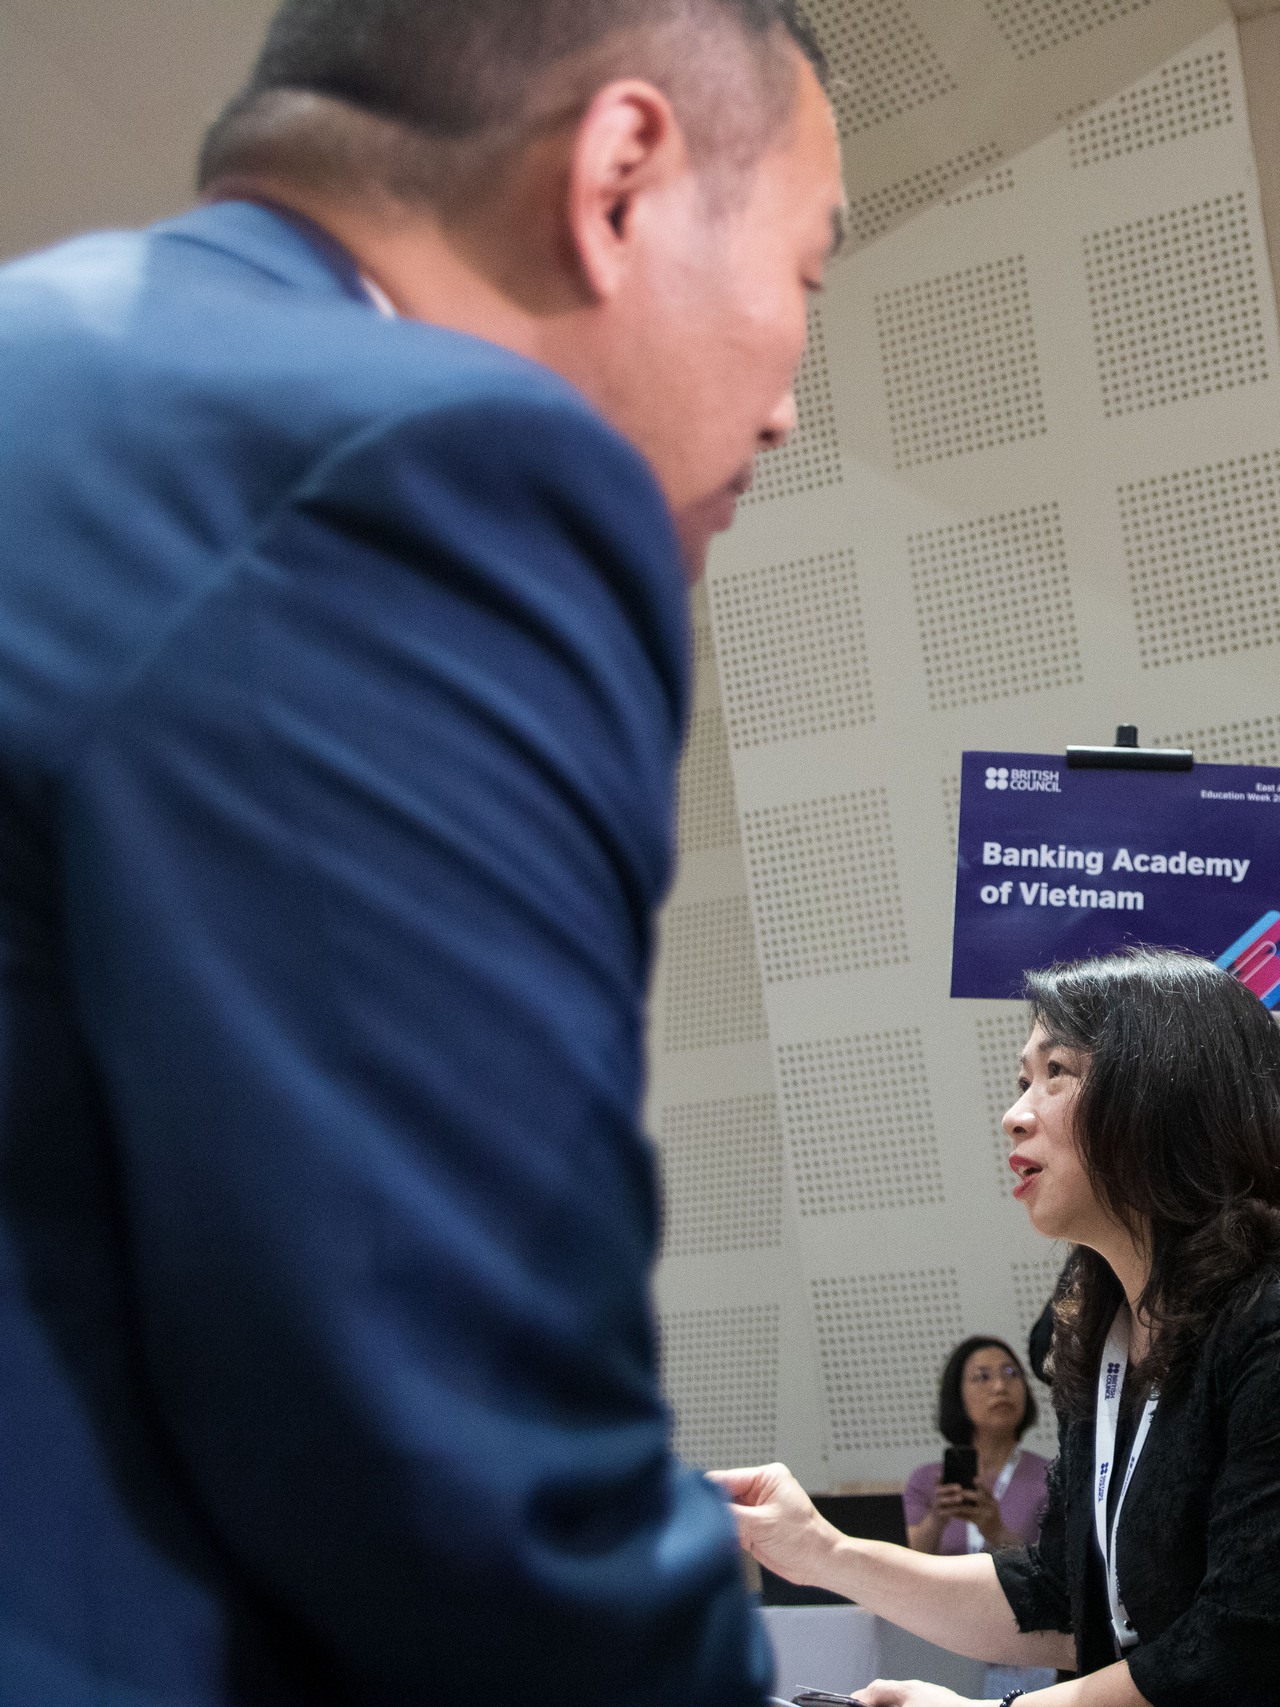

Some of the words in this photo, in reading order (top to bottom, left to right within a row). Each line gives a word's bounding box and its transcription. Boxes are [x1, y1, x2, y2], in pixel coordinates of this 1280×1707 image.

[1011, 769, 1060, 781] BRITISH
[1010, 779, 1062, 793] COUNCIL
[1256, 782, 1276, 793] East
[1200, 789, 1245, 801] Education
[1247, 792, 1272, 803] Week
[982, 842, 1104, 875] Banking
[1112, 849, 1250, 883] Academy
[980, 881, 1014, 906] of
[1020, 882, 1145, 911] Vietnam
